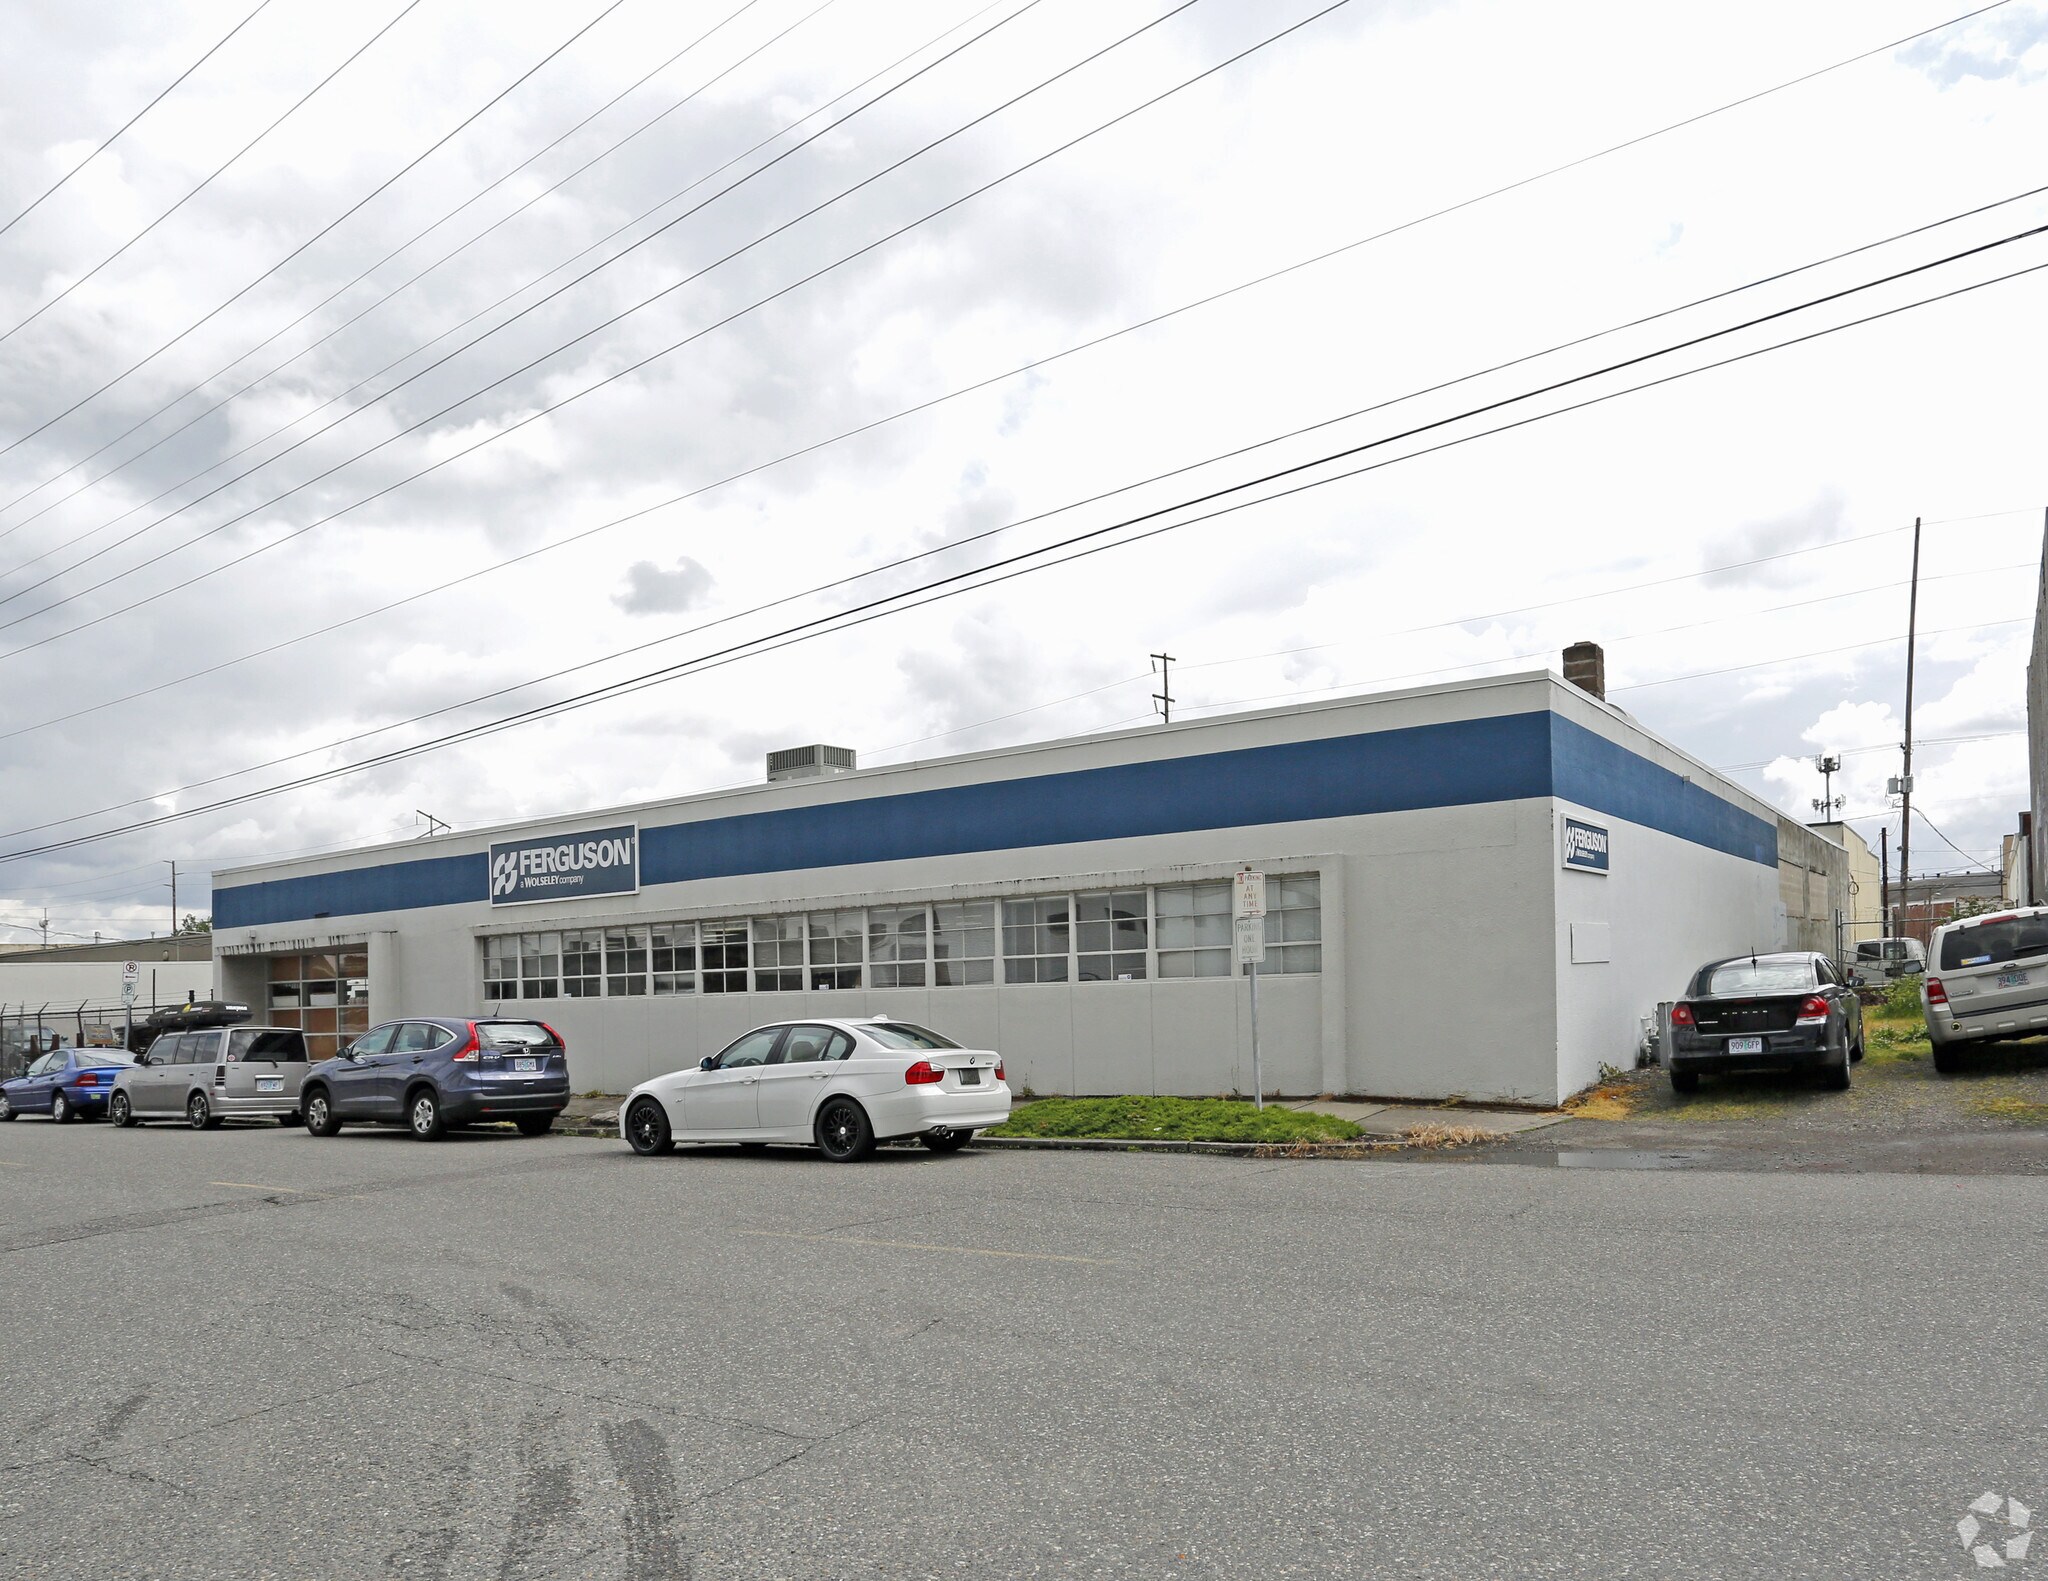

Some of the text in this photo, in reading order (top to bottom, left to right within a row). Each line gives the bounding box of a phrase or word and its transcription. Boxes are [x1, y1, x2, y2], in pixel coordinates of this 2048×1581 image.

[1575, 827, 1607, 853] FERGUSON
[520, 838, 630, 875] FERGUSON
[524, 875, 560, 888] WOLSELEY
[559, 875, 584, 885] company
[1243, 892, 1257, 900] ANY
[1243, 900, 1258, 908] TIME
[1244, 934, 1256, 943] ONE
[1731, 1040, 1760, 1050] 909 GFP
